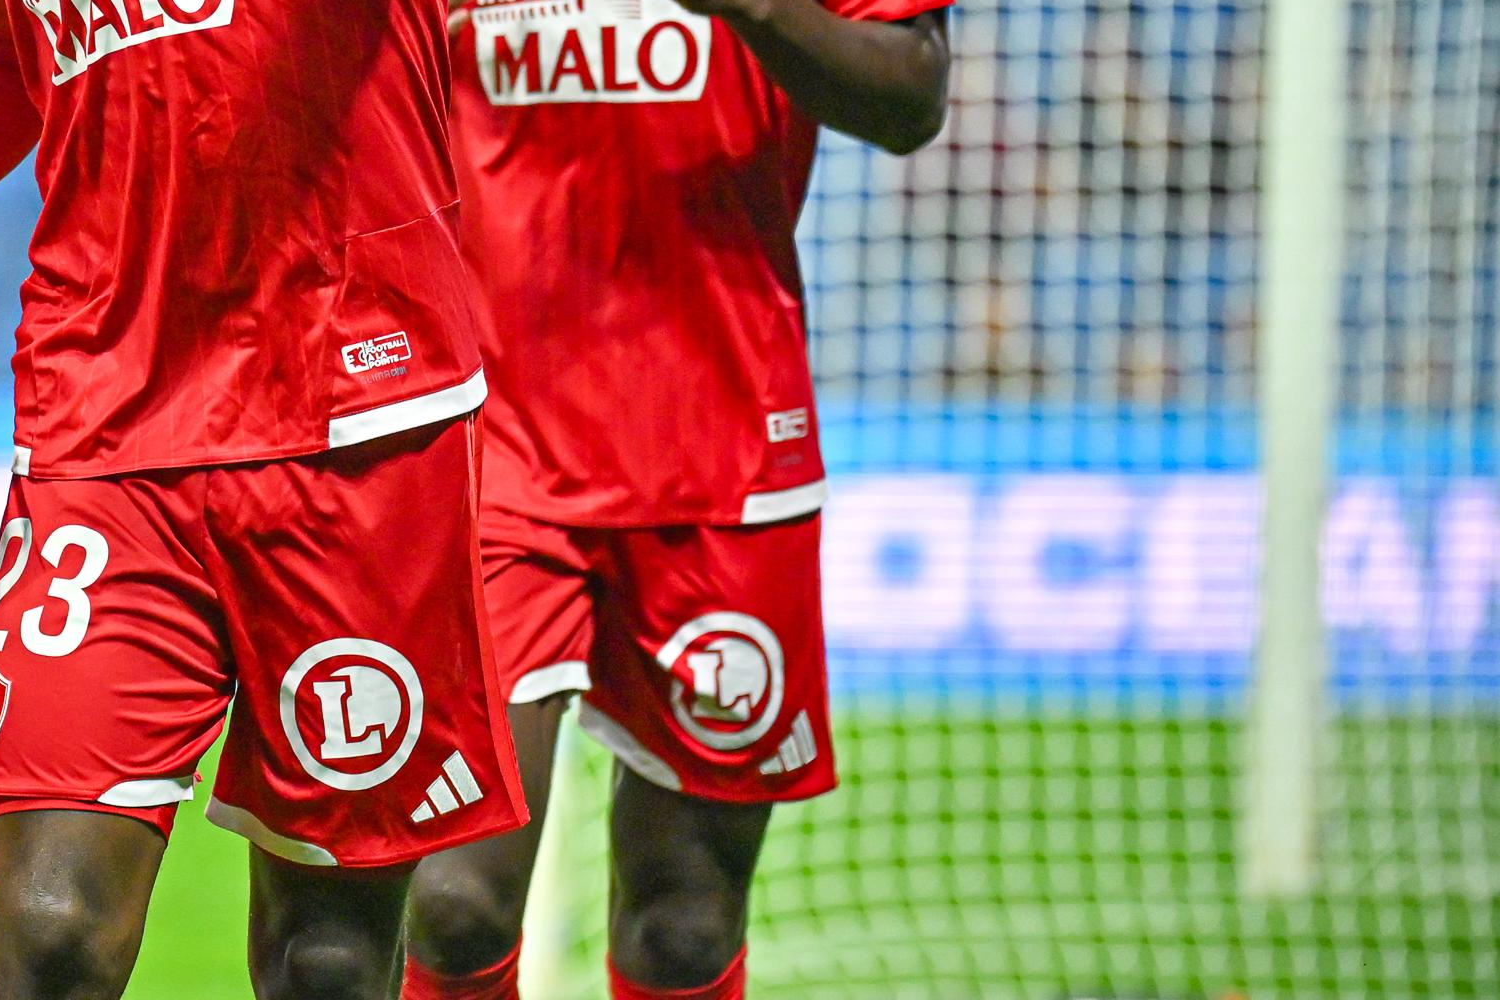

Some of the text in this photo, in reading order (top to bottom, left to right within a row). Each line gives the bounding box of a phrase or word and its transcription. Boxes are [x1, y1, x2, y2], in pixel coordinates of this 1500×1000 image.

[494, 21, 698, 93] MALO
[365, 339, 406, 356] FOOTBALL
[369, 354, 400, 369] POINTE
[820, 470, 1500, 655] OCEA
